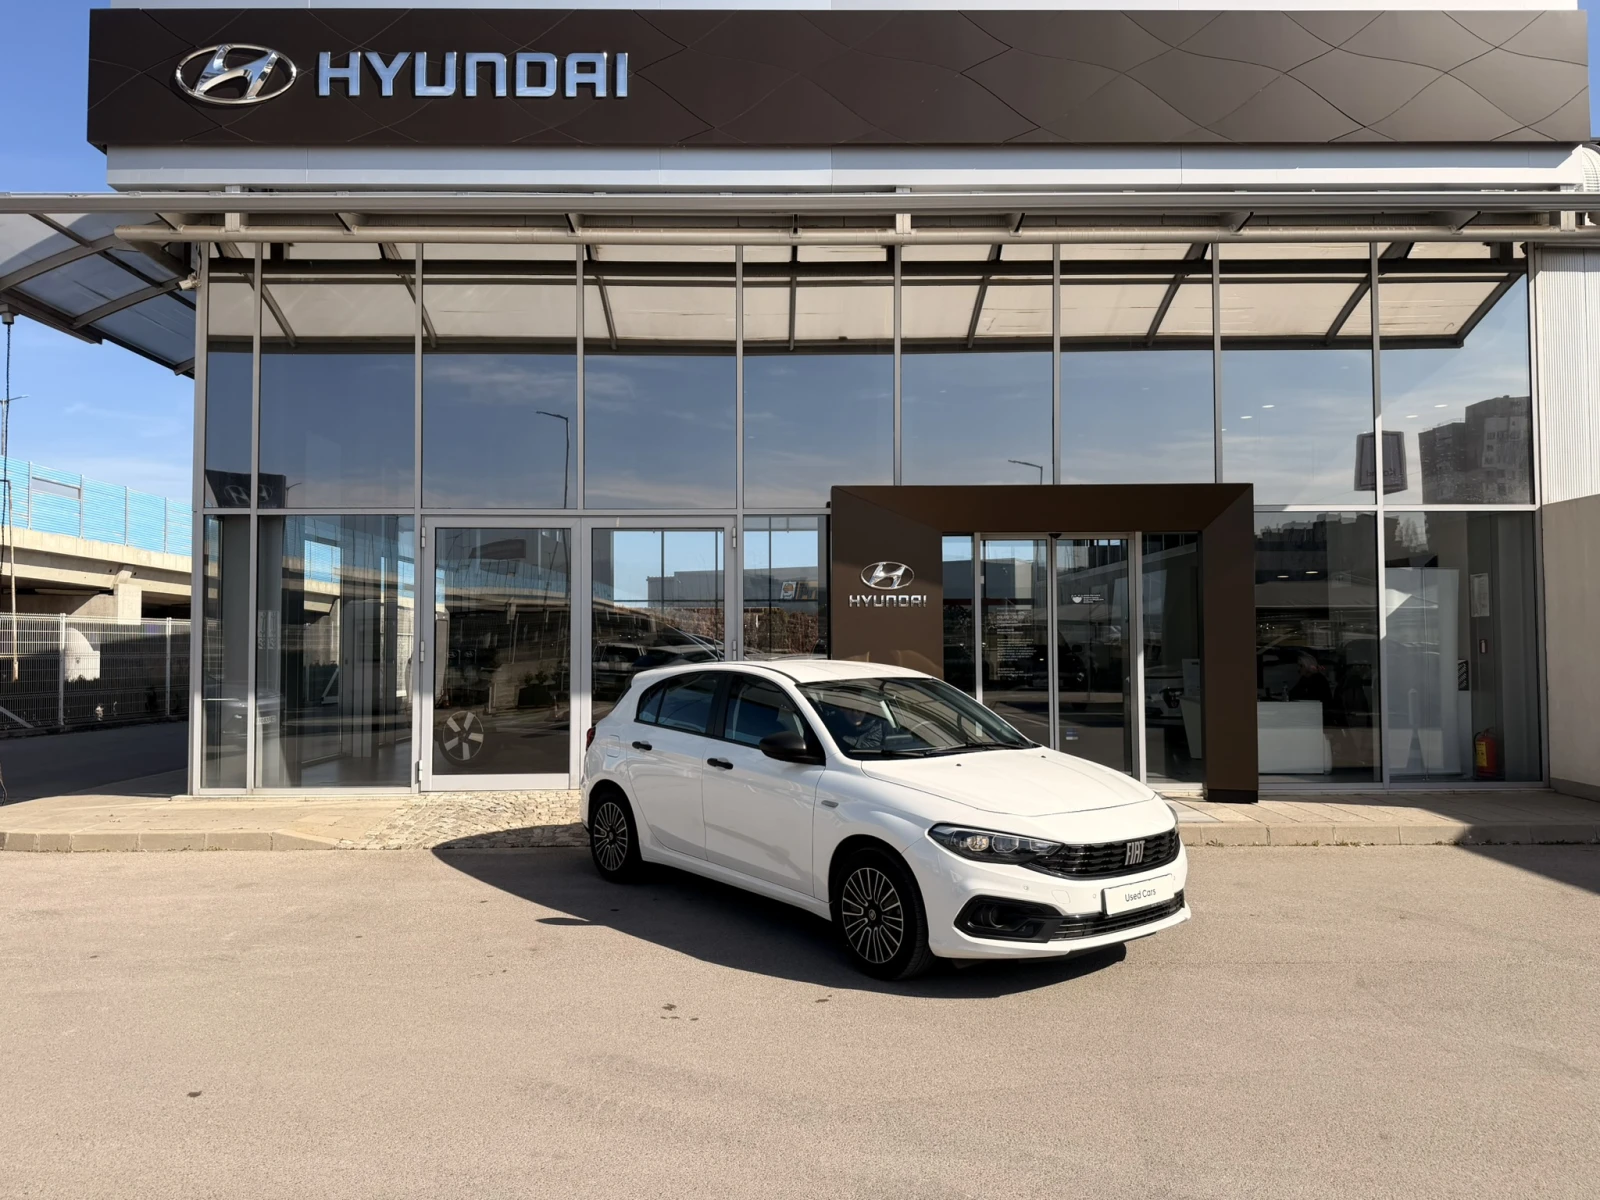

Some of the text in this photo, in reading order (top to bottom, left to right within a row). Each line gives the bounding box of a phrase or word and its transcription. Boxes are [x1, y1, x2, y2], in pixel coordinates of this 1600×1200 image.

[318, 51, 629, 97] HYUNDAI
[848, 594, 927, 608] HYUNDAI
[1124, 840, 1146, 866] FIAT
[1124, 888, 1157, 902] Used Cars
